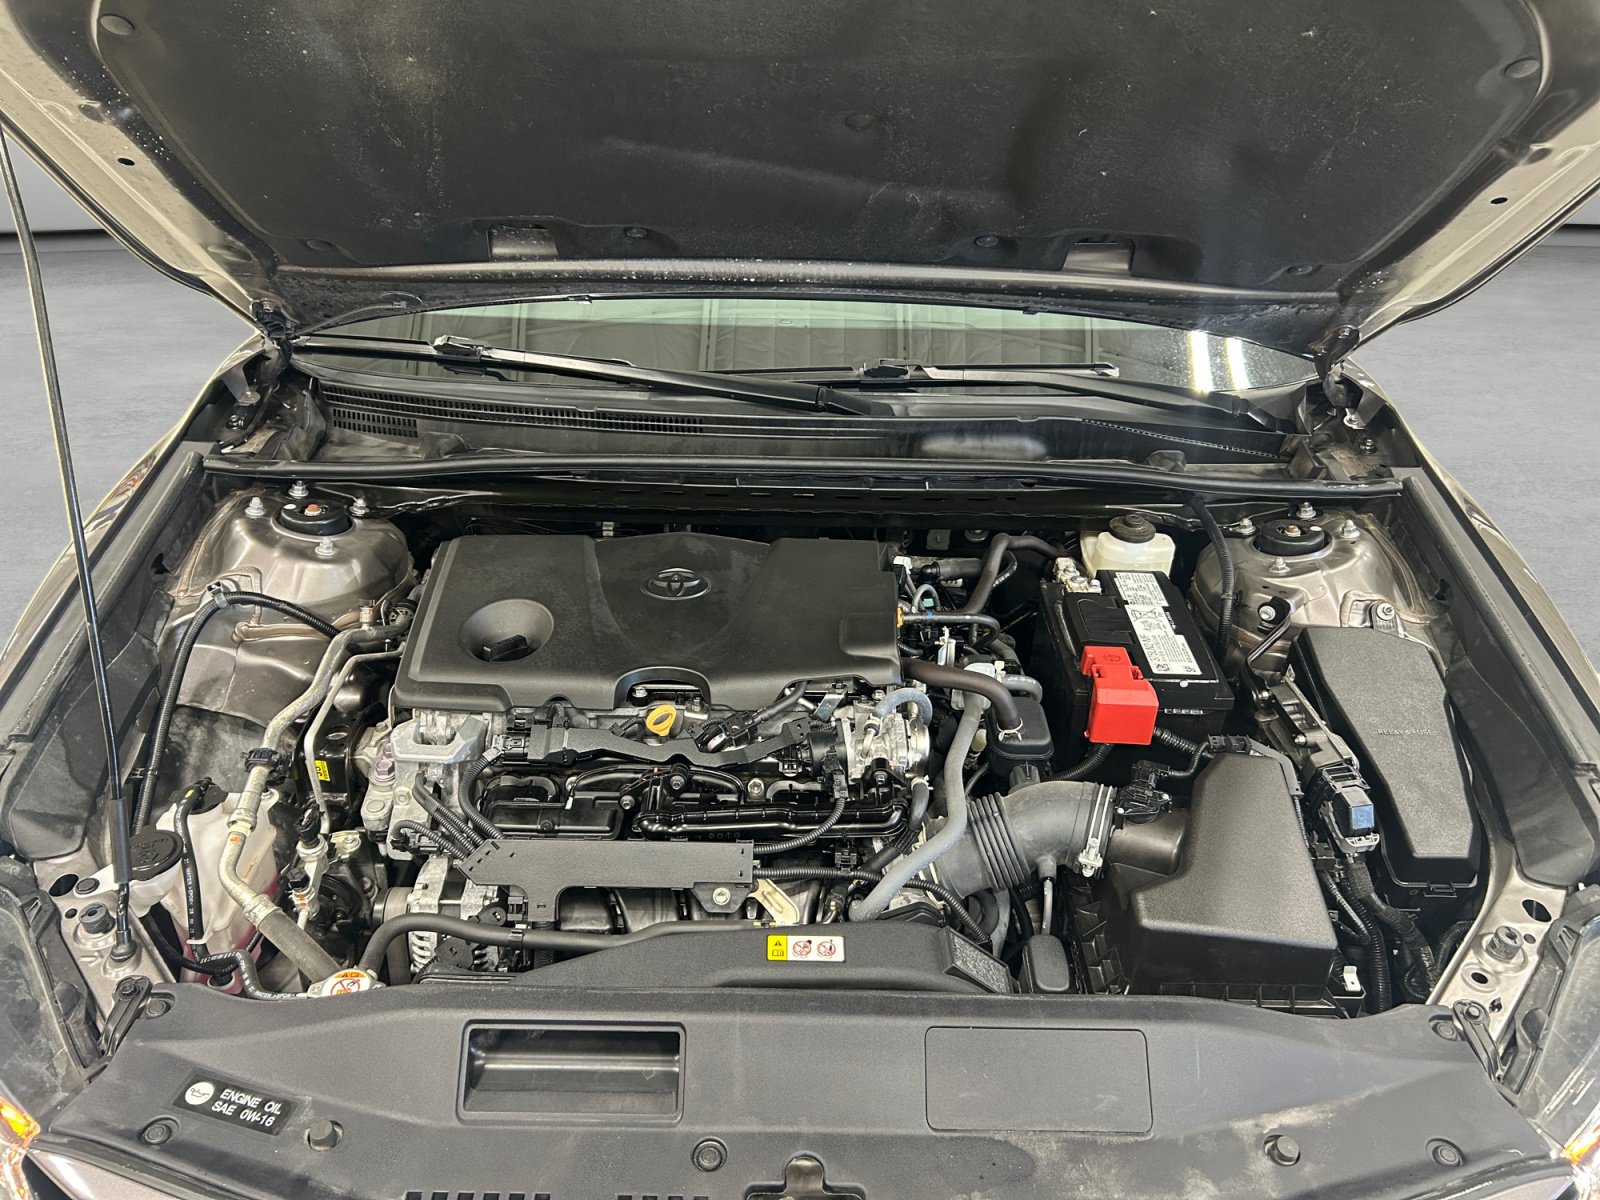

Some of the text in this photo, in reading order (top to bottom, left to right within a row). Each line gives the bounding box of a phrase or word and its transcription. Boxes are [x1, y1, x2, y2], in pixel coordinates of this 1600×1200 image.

[1376, 728, 1403, 736] RELAY
[211, 1101, 276, 1127] SAE 0W-16
[219, 1088, 282, 1115] ENGINE OIL
